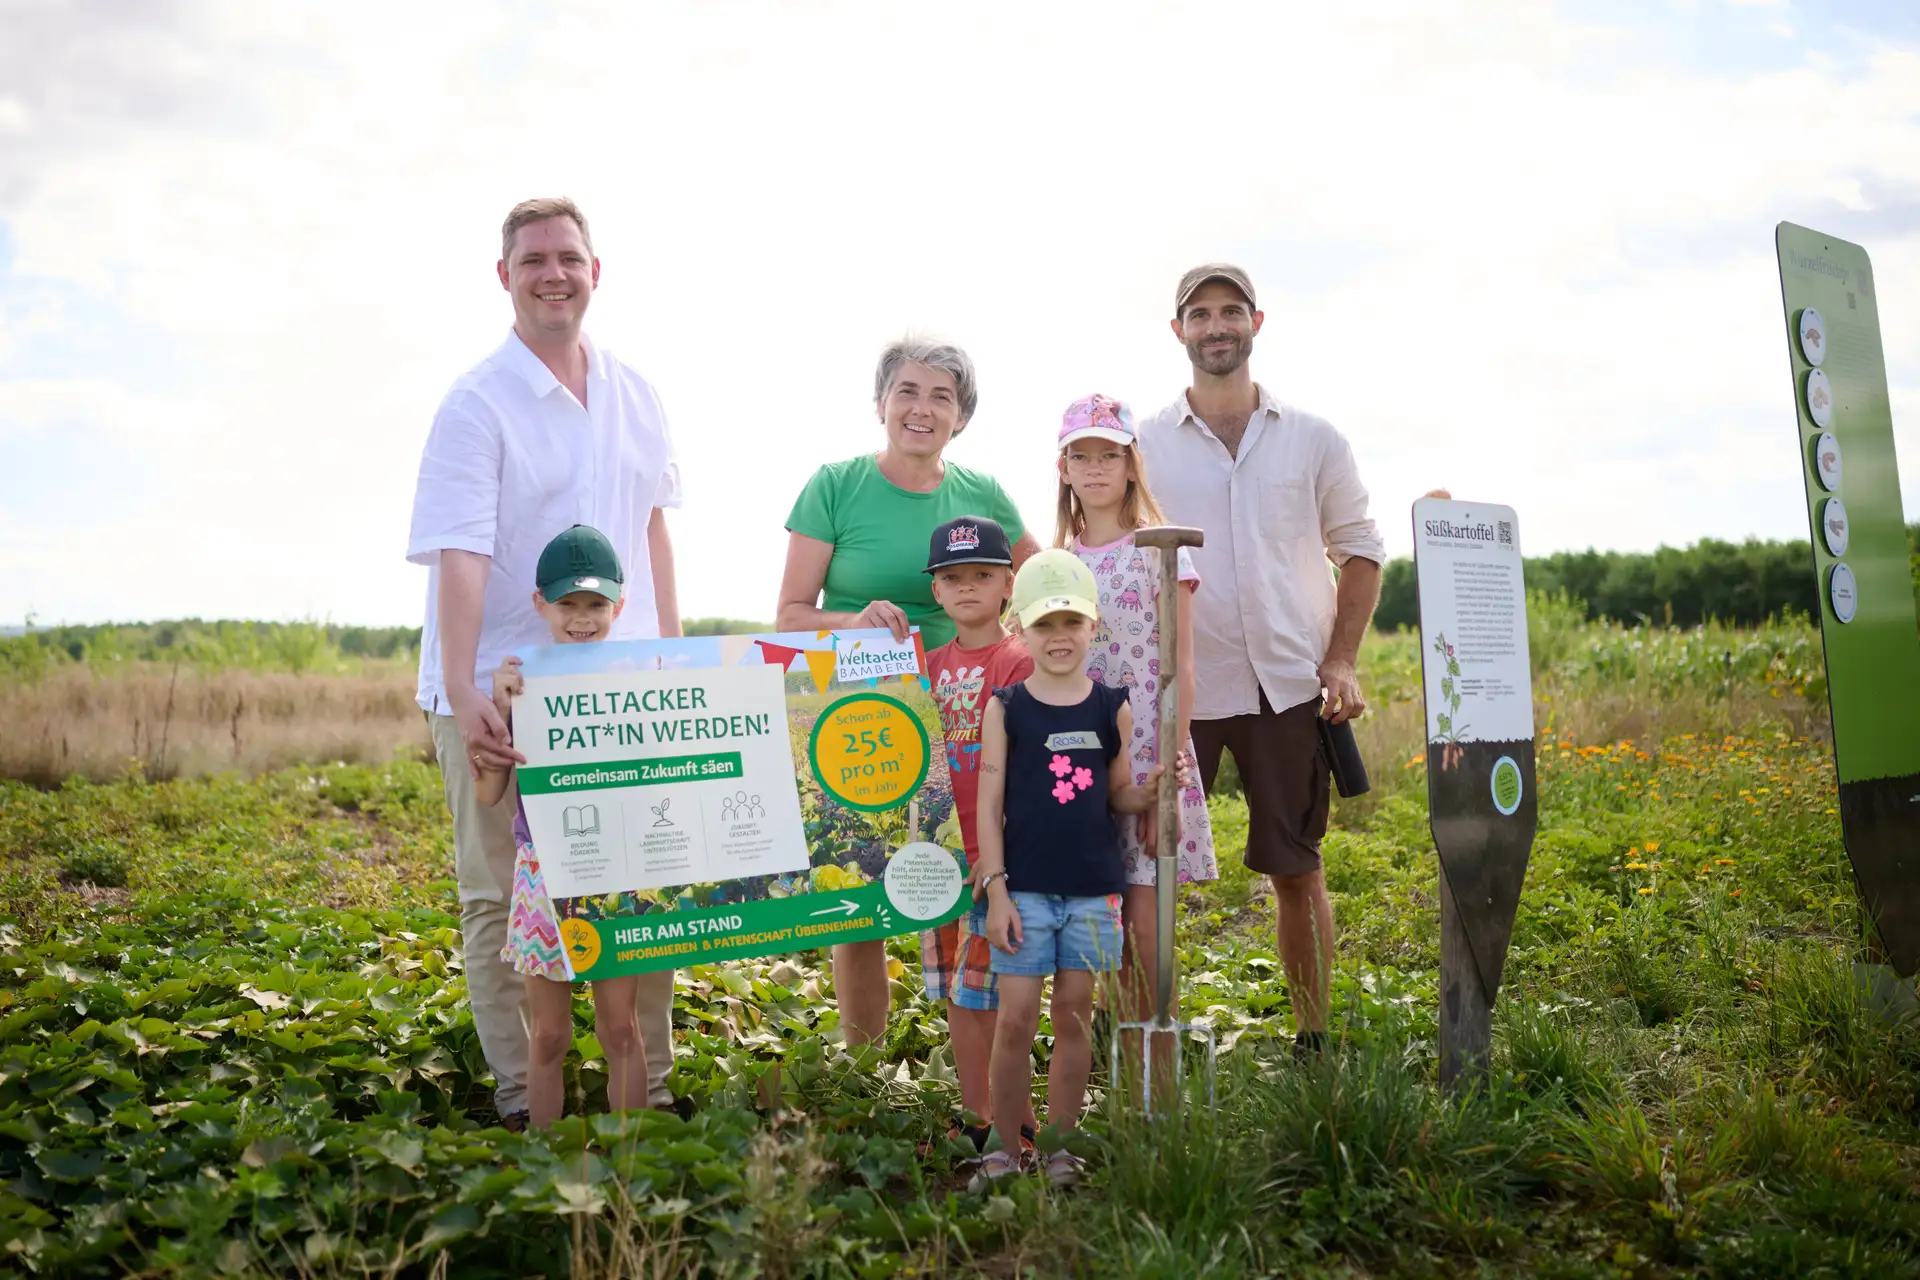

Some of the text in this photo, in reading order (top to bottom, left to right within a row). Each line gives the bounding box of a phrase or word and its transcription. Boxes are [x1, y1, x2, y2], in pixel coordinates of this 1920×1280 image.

[1425, 520, 1495, 541] Süßkartoffel
[838, 645, 914, 665] Weltacker
[840, 662, 915, 678] BAMBERG
[544, 687, 707, 718] WELTACKER
[836, 708, 891, 725] Schon ab
[652, 713, 770, 743] WERDEN!
[843, 727, 893, 757] 25€
[1052, 736, 1086, 748] Rosa
[549, 760, 734, 787] Gemeinsam Zukunft säen
[840, 763, 875, 784] pro
[854, 781, 898, 796] im Jahr
[614, 915, 742, 944] HIER AM STAND
[617, 916, 875, 962] INFORMIEREN & PATENSCHAFT ÜBERNEHMEN
